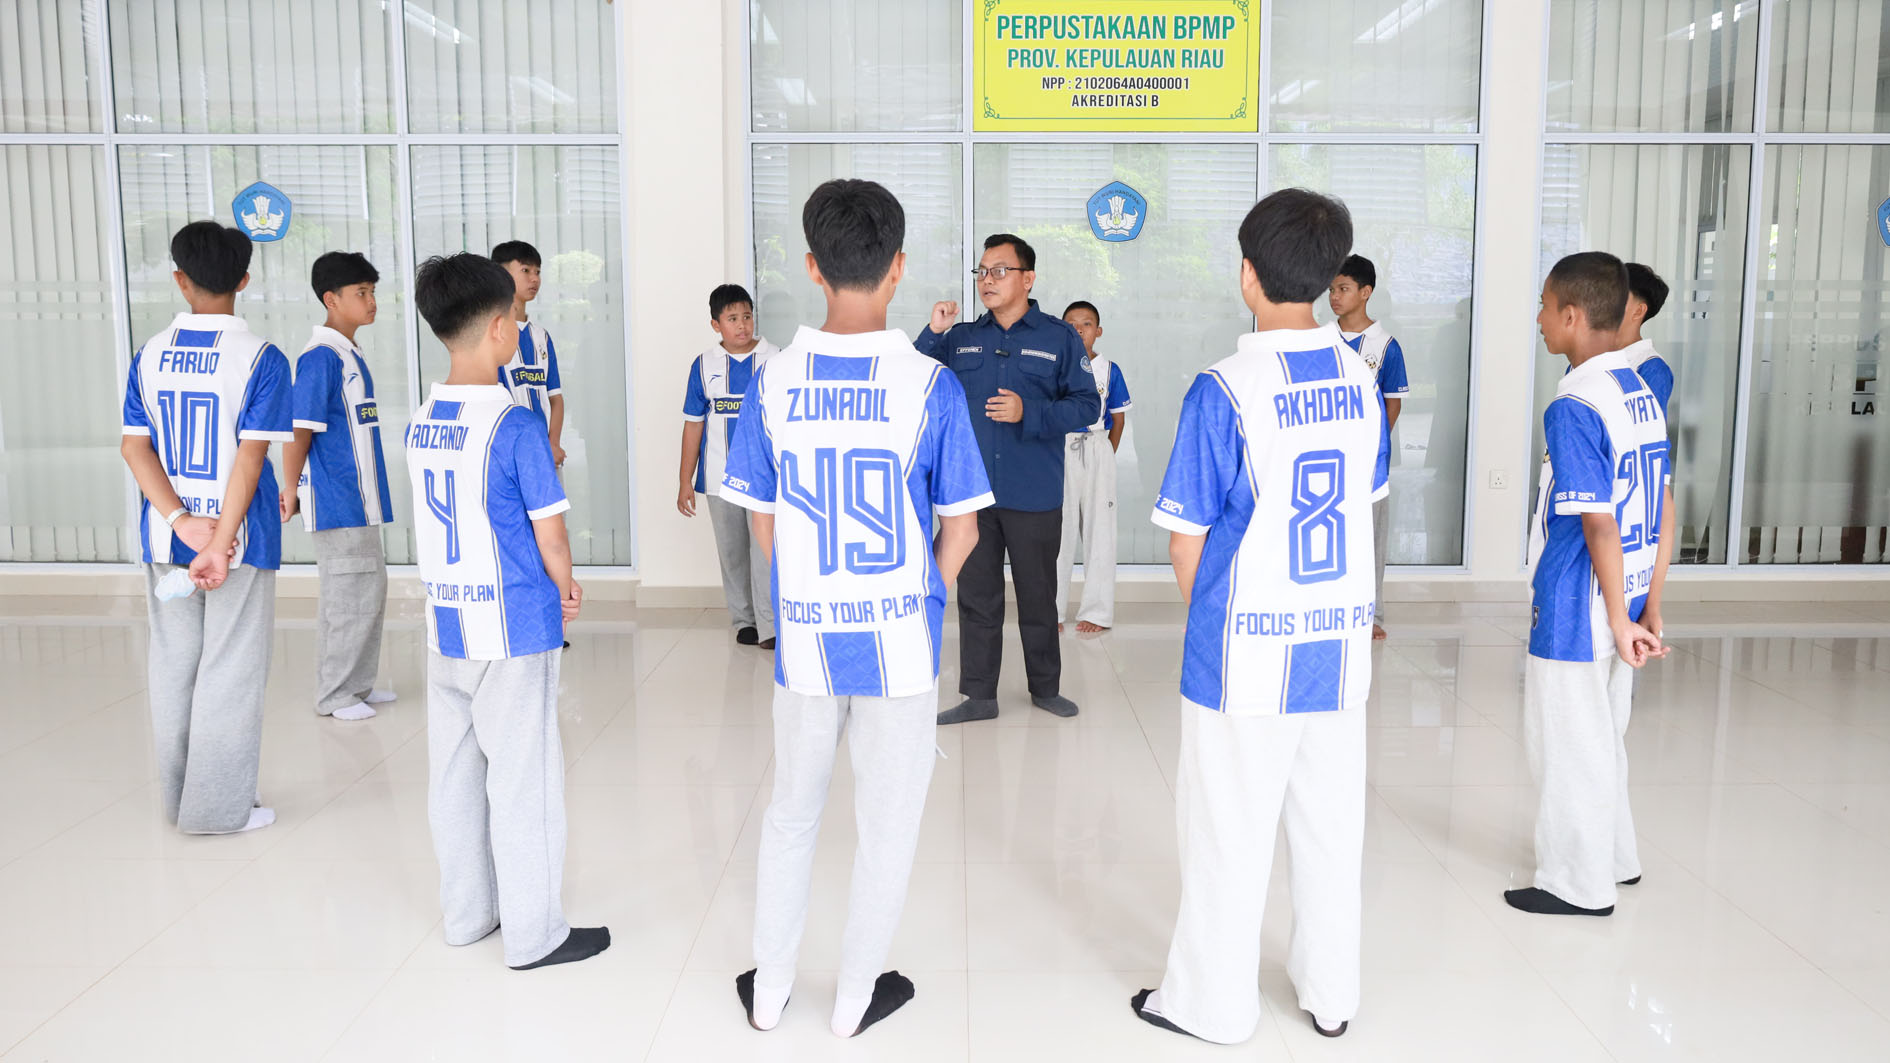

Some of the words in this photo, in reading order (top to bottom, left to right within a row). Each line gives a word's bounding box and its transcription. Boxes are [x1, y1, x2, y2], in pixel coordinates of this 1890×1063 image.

[997, 15, 1167, 40] PERPUSTAKAAN
[1173, 15, 1236, 40] BPMP
[1007, 48, 1060, 69] PROV.
[1066, 48, 1175, 69] KEPULAUAN
[1181, 48, 1224, 69] RIAU
[1042, 77, 1065, 90] NPP
[1075, 77, 1190, 90] 2102064A0400001
[1071, 94, 1147, 107] AKREDITASI
[1151, 94, 1159, 107] B
[159, 350, 220, 376] FARUQ
[786, 387, 890, 423] ZUNADIL
[1273, 385, 1365, 429] AKHDAN
[157, 390, 219, 480] 10
[411, 424, 469, 451] ADZANDI
[728, 476, 750, 492] 2024
[180, 496, 201, 513] OUR
[206, 498, 221, 515] PL
[1160, 497, 1184, 515] 2024
[1616, 440, 1669, 555] 20
[780, 447, 906, 576] 49
[1289, 449, 1347, 585] 8
[436, 583, 459, 602] YOUR
[463, 583, 495, 602] PLAN
[782, 597, 822, 624] FOCUS
[829, 600, 875, 624] YOUR
[1235, 613, 1295, 636] FOCUS
[1304, 607, 1345, 633] YOUR
[1353, 602, 1375, 628] PLA
